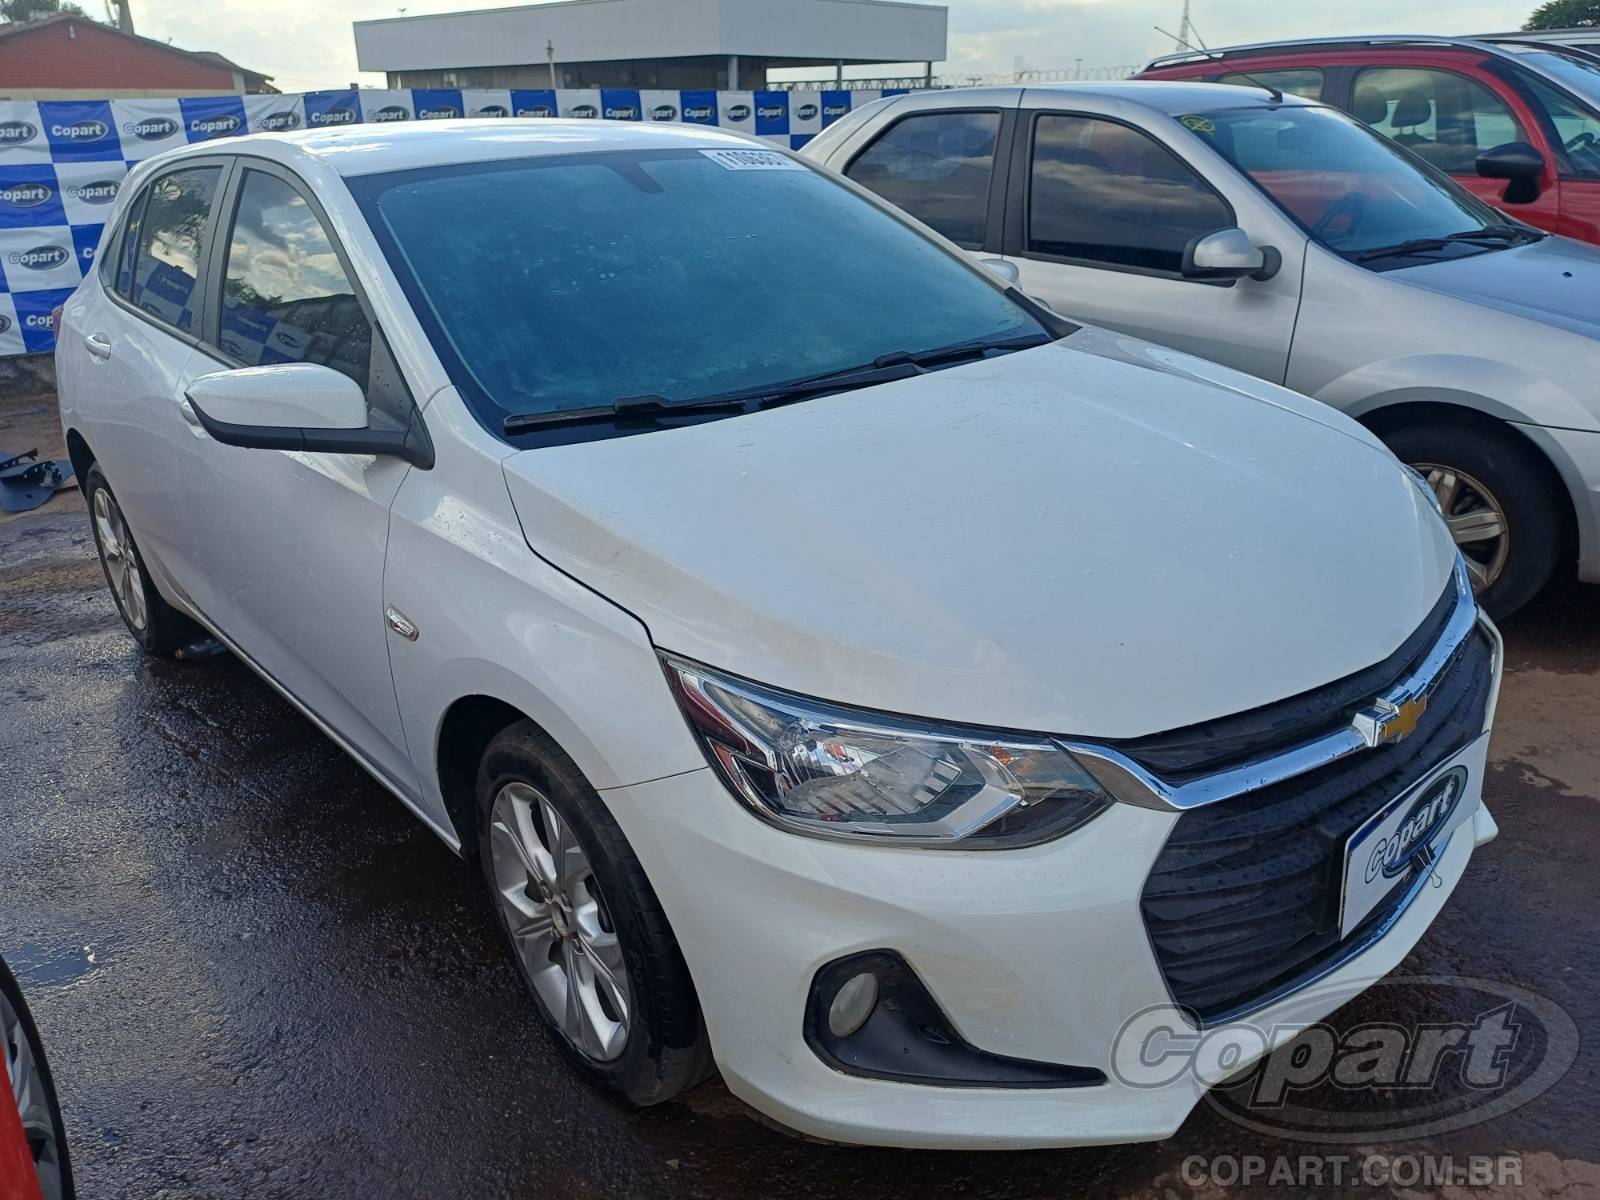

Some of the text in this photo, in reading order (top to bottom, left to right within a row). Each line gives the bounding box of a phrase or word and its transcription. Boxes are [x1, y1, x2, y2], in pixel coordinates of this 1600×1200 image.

[311, 111, 350, 124] Copart
[52, 124, 102, 138] Copart
[123, 122, 171, 136] Copart
[191, 118, 235, 132] Copart
[67, 185, 115, 199] Copart
[9, 250, 60, 265] Copart
[1365, 772, 1456, 884] Copart
